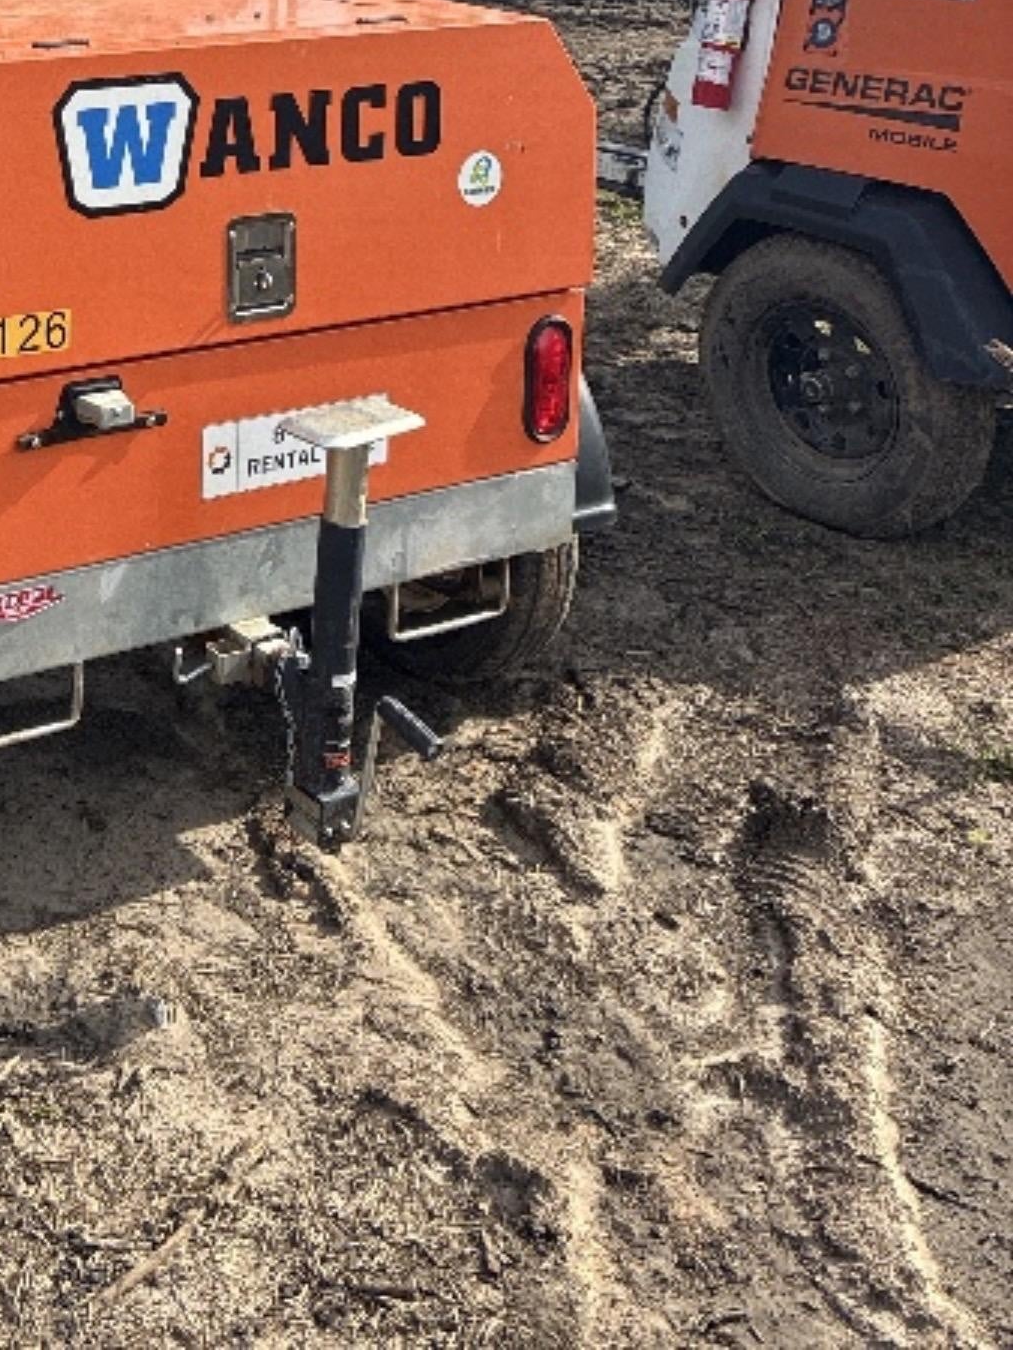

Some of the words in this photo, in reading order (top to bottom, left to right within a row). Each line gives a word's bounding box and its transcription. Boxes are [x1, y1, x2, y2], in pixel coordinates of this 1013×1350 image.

[784, 66, 966, 112] GENERAC
[76, 80, 443, 190] WANCO
[868, 127, 958, 153] MOBILE
[247, 446, 321, 477] RENTAL
